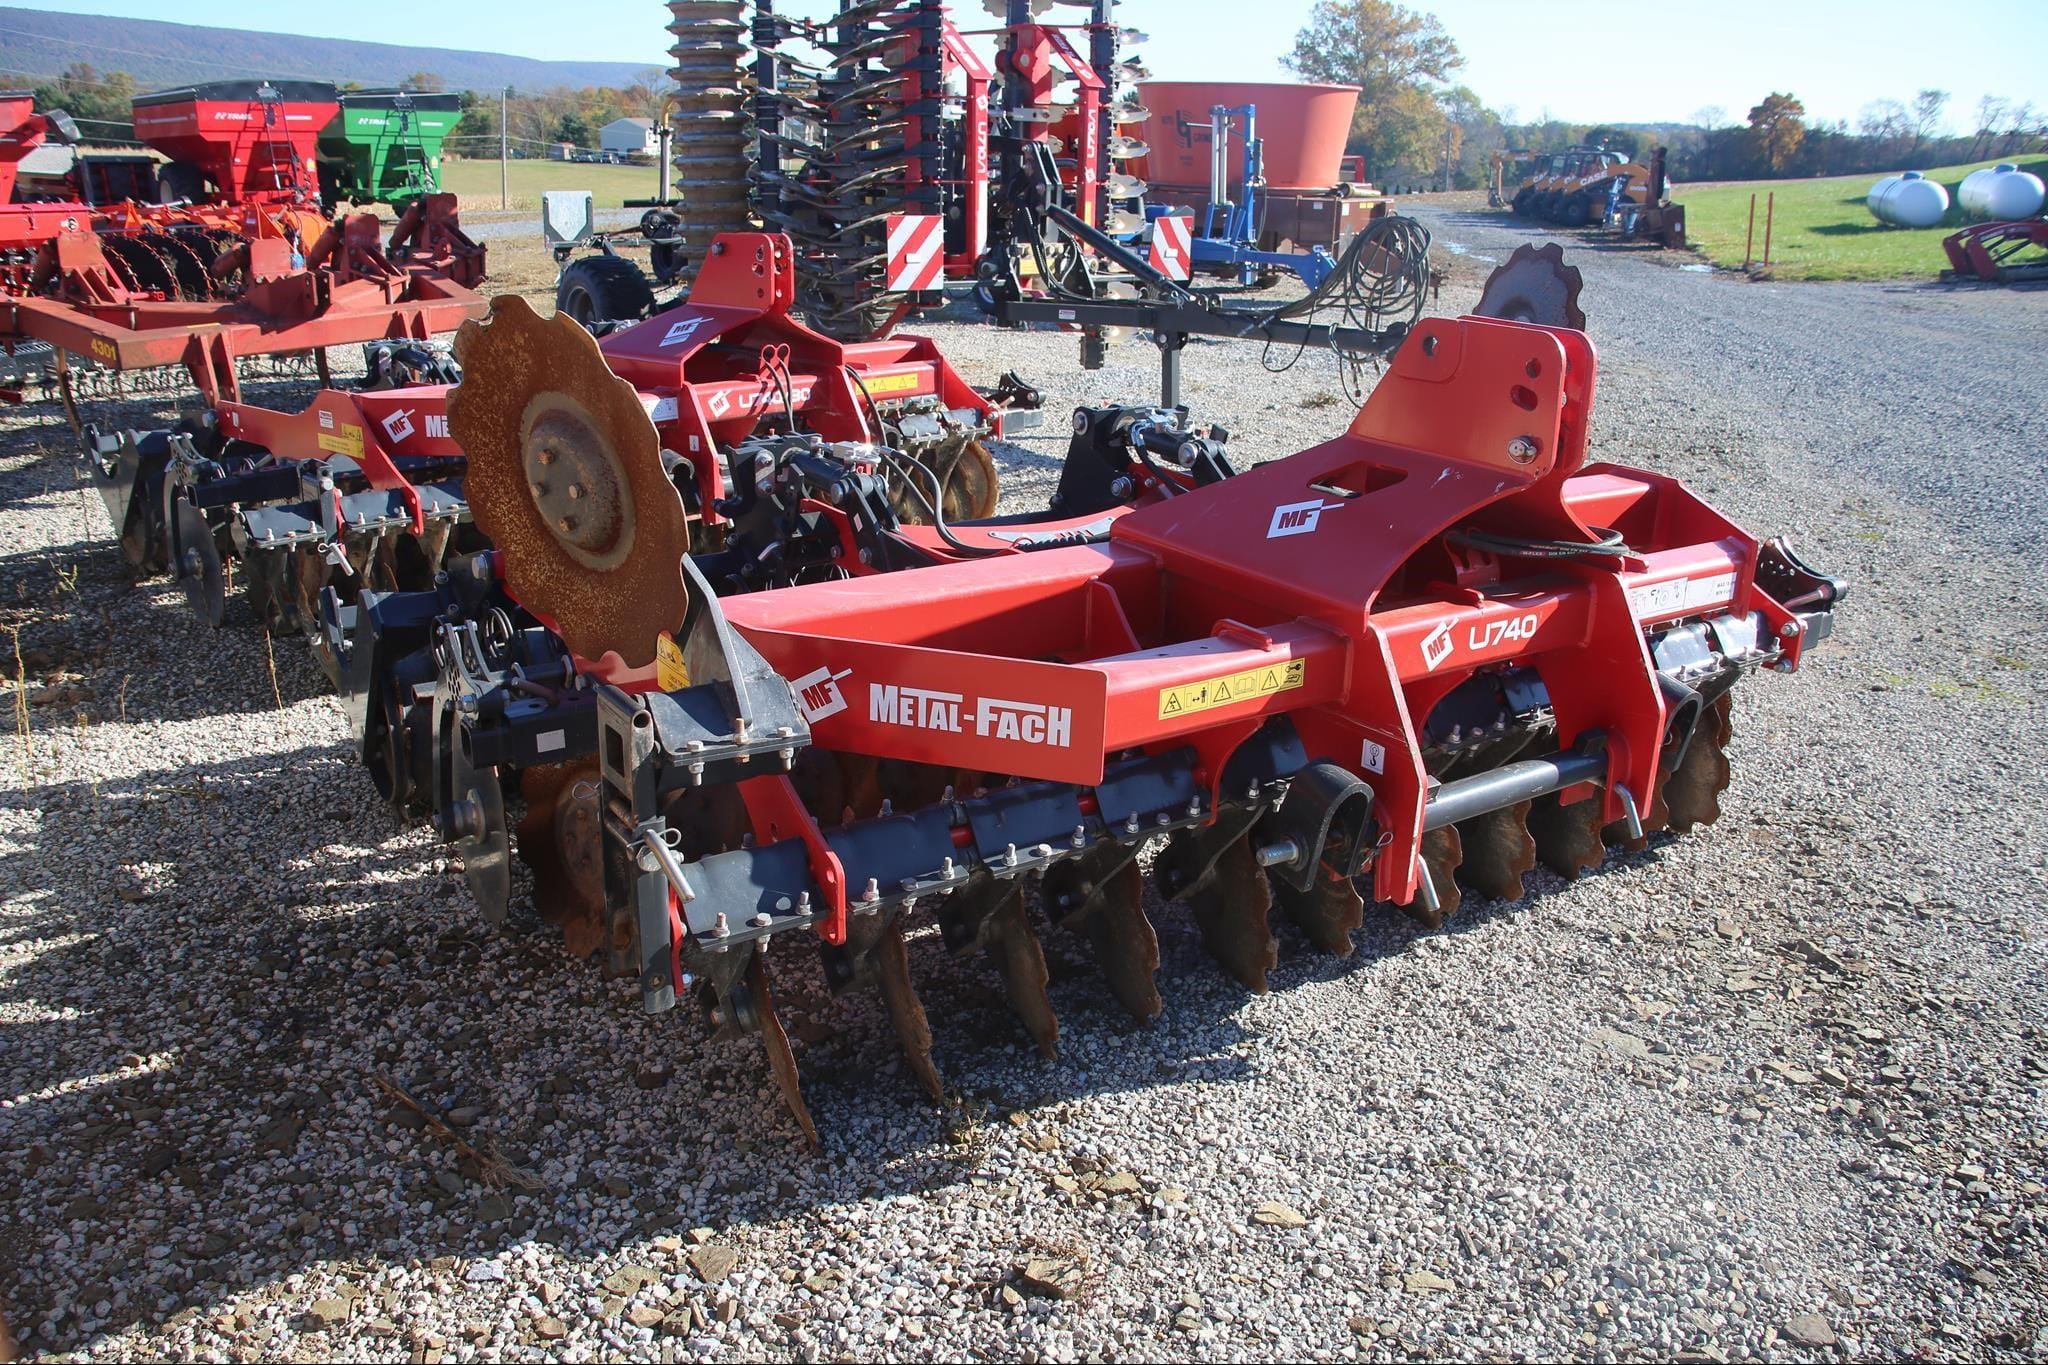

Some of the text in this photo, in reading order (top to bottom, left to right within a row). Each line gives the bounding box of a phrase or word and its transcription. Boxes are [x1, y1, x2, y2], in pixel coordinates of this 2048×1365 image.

[1580, 170, 1608, 186] CASE
[91, 338, 117, 361] 4301
[1469, 613, 1538, 651] U740
[869, 682, 1072, 748] METAL-FACH
